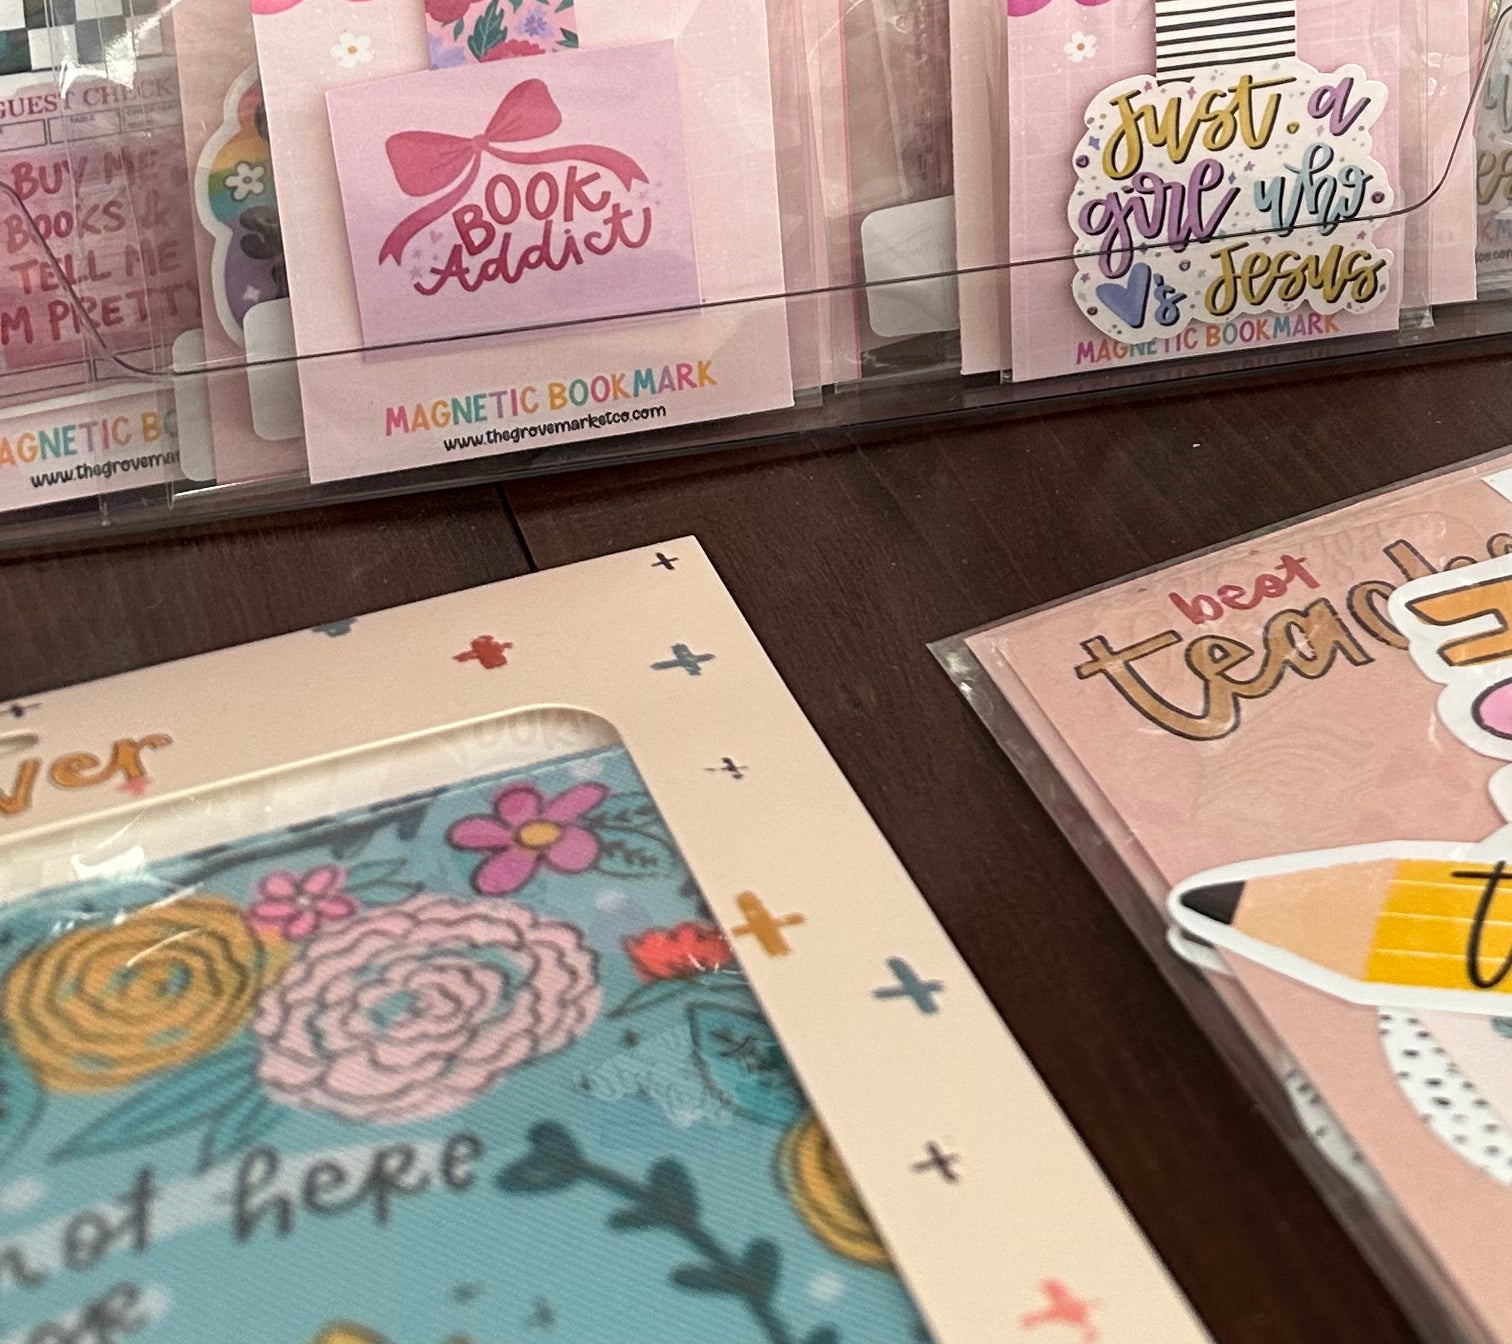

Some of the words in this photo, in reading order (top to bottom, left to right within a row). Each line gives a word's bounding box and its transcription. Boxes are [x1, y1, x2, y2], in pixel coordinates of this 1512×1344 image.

[1102, 75, 1296, 179] Just
[1307, 77, 1371, 136] a
[12, 156, 88, 201] BUY
[453, 165, 610, 257] BOOK
[1078, 158, 1240, 278] girl
[1254, 143, 1373, 236] who
[3, 199, 125, 253] BOOKS
[414, 207, 651, 295] Addict
[10, 251, 111, 295] TELL
[125, 240, 179, 277] ME
[1204, 242, 1386, 316] Jesus
[48, 280, 200, 340] PRETTY
[1206, 311, 1340, 346] BOOKMARK
[385, 386, 539, 436] MAGNETIC
[549, 360, 717, 410] BOOKMARK
[444, 405, 666, 451] www.thegrovemarketco.com
[1169, 554, 1322, 625] best
[232, 1132, 484, 1243] here
